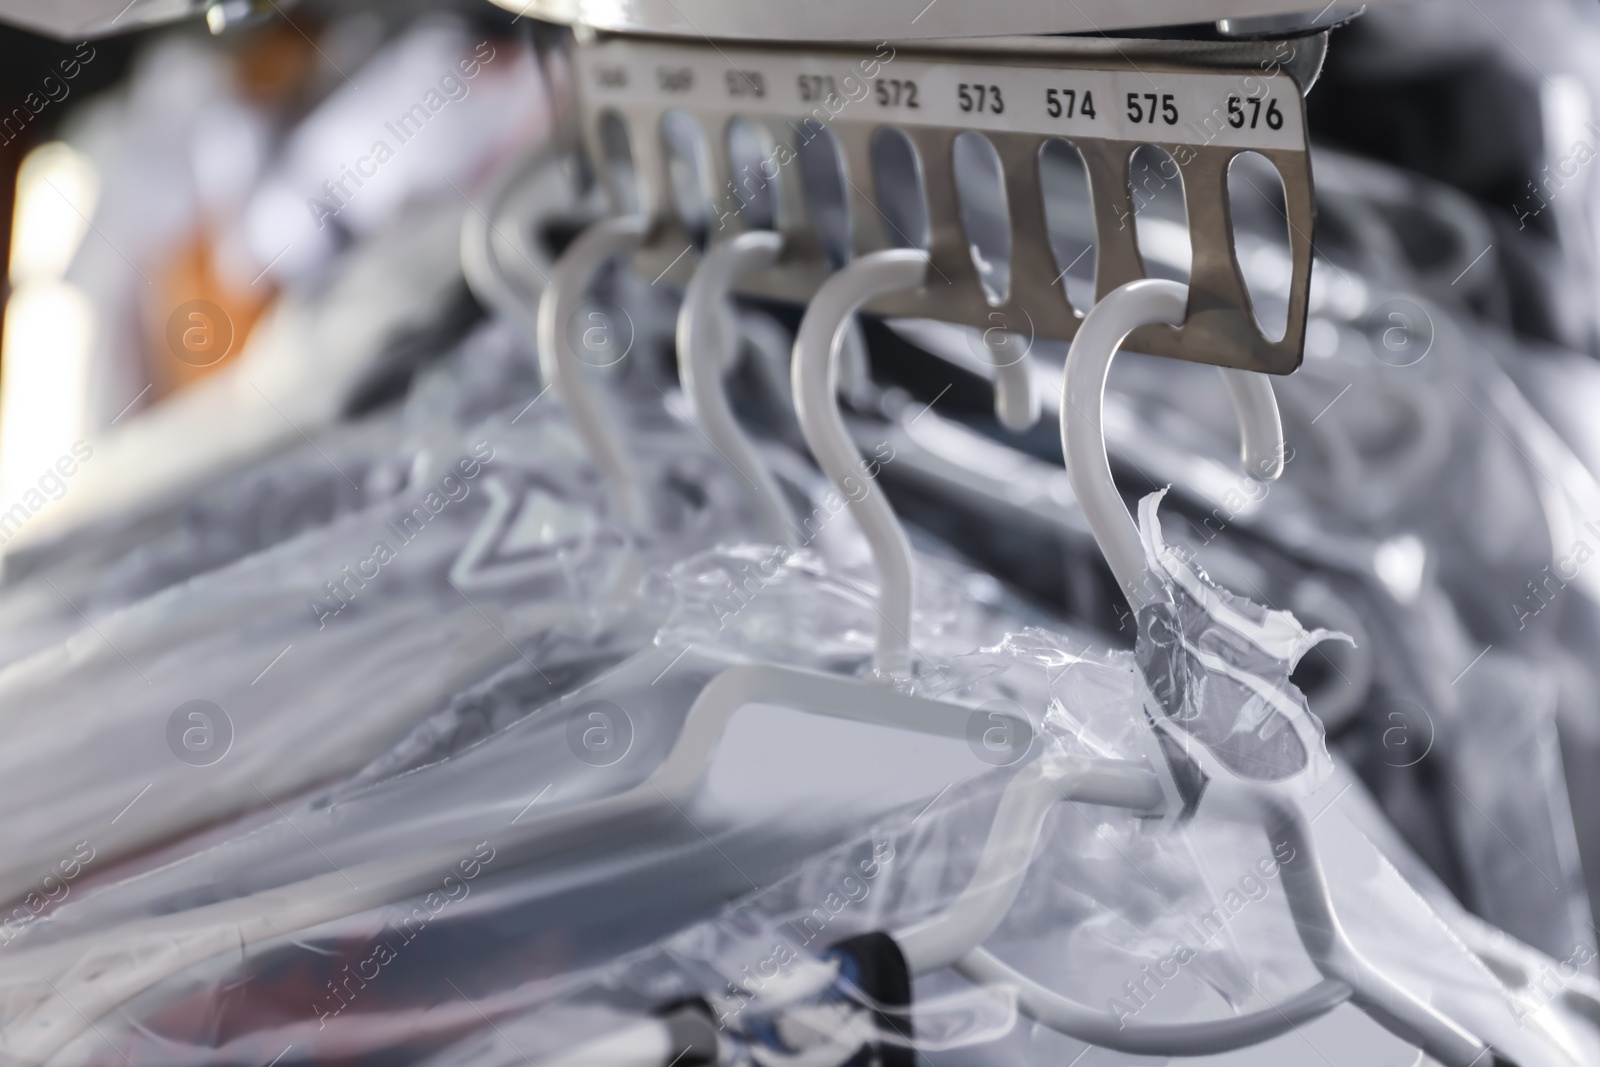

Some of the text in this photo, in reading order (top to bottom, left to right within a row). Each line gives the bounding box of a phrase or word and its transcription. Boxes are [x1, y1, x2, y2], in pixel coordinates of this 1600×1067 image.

[875, 78, 919, 108] 572
[958, 83, 1004, 114] 573
[1046, 88, 1096, 120] 574
[1127, 92, 1178, 125] 575
[1228, 96, 1283, 130] 576
